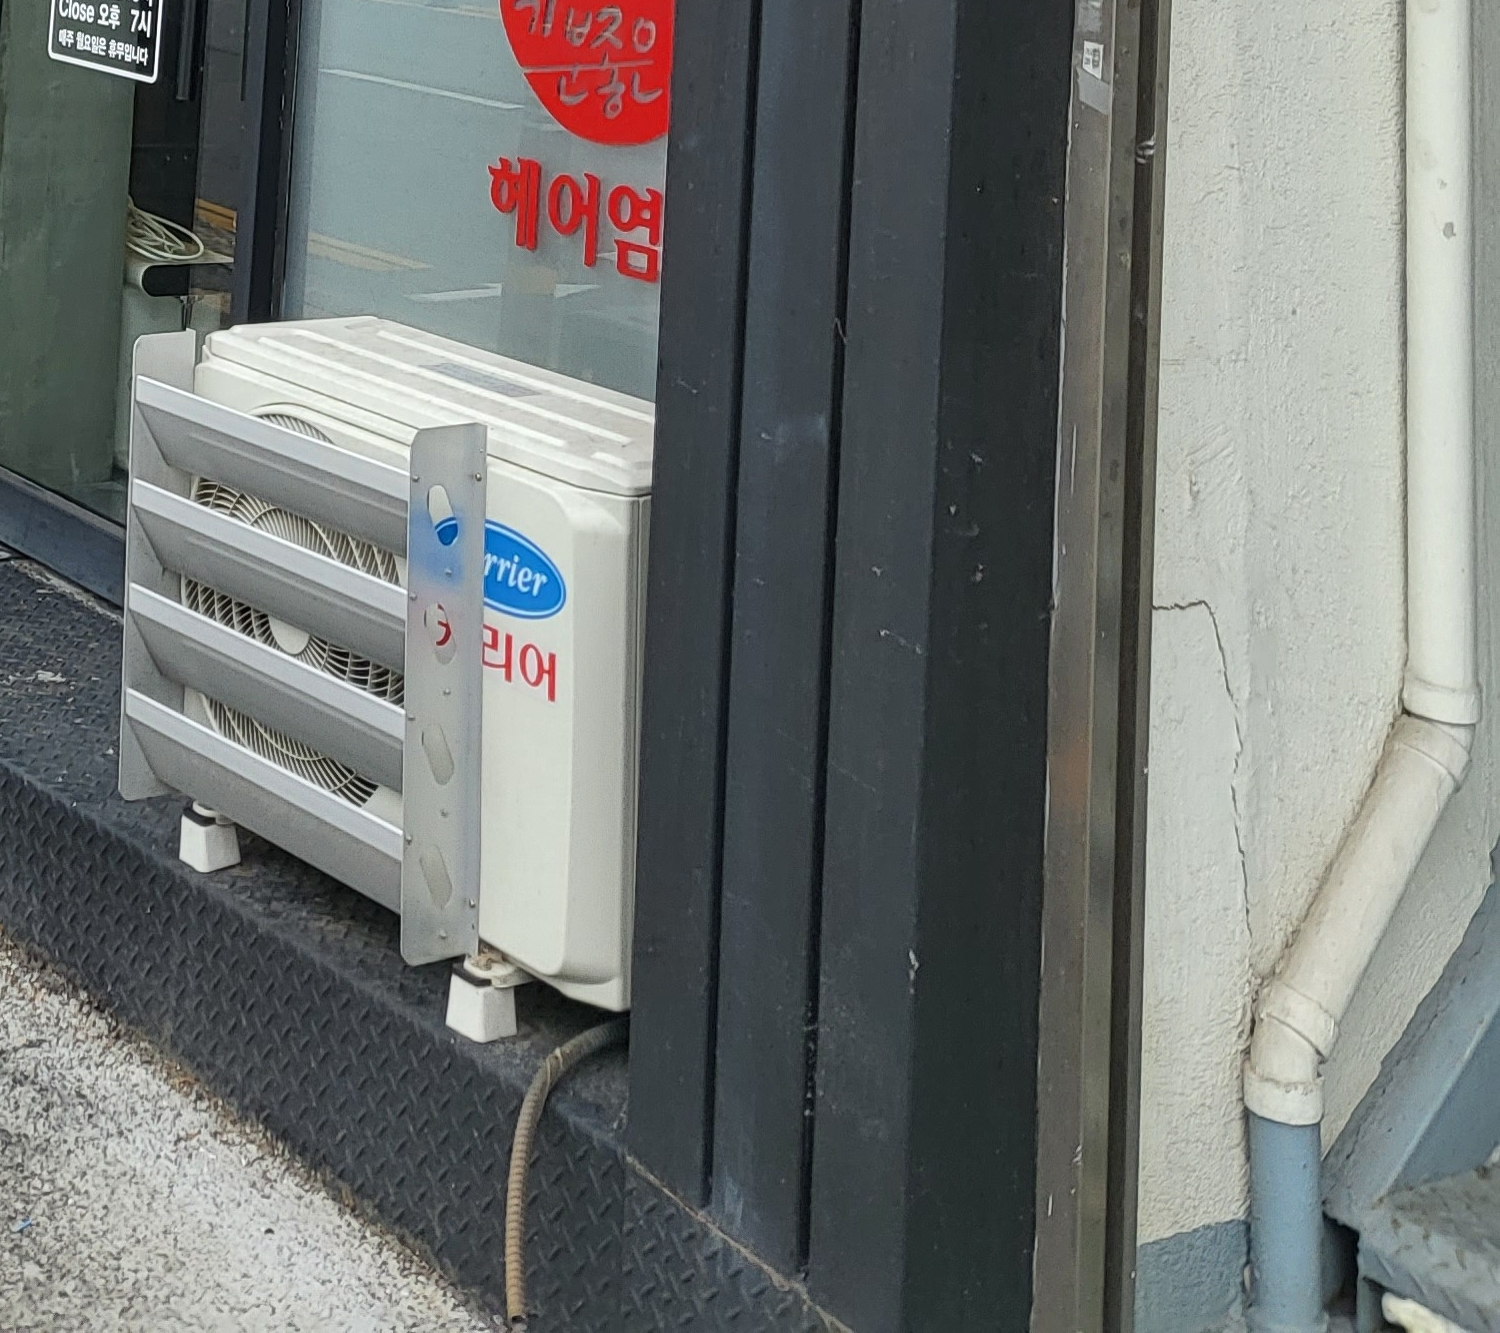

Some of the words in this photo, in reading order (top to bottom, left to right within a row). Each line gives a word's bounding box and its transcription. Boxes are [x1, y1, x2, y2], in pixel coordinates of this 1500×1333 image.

[97, 3, 121, 30] 오후
[130, 9, 152, 38] 7시
[58, 28, 75, 48] 매주
[76, 31, 107, 56] 월요일은
[108, 39, 149, 66] 휴무입니다
[488, 157, 663, 283] 헤어염
[484, 552, 548, 597] rrier
